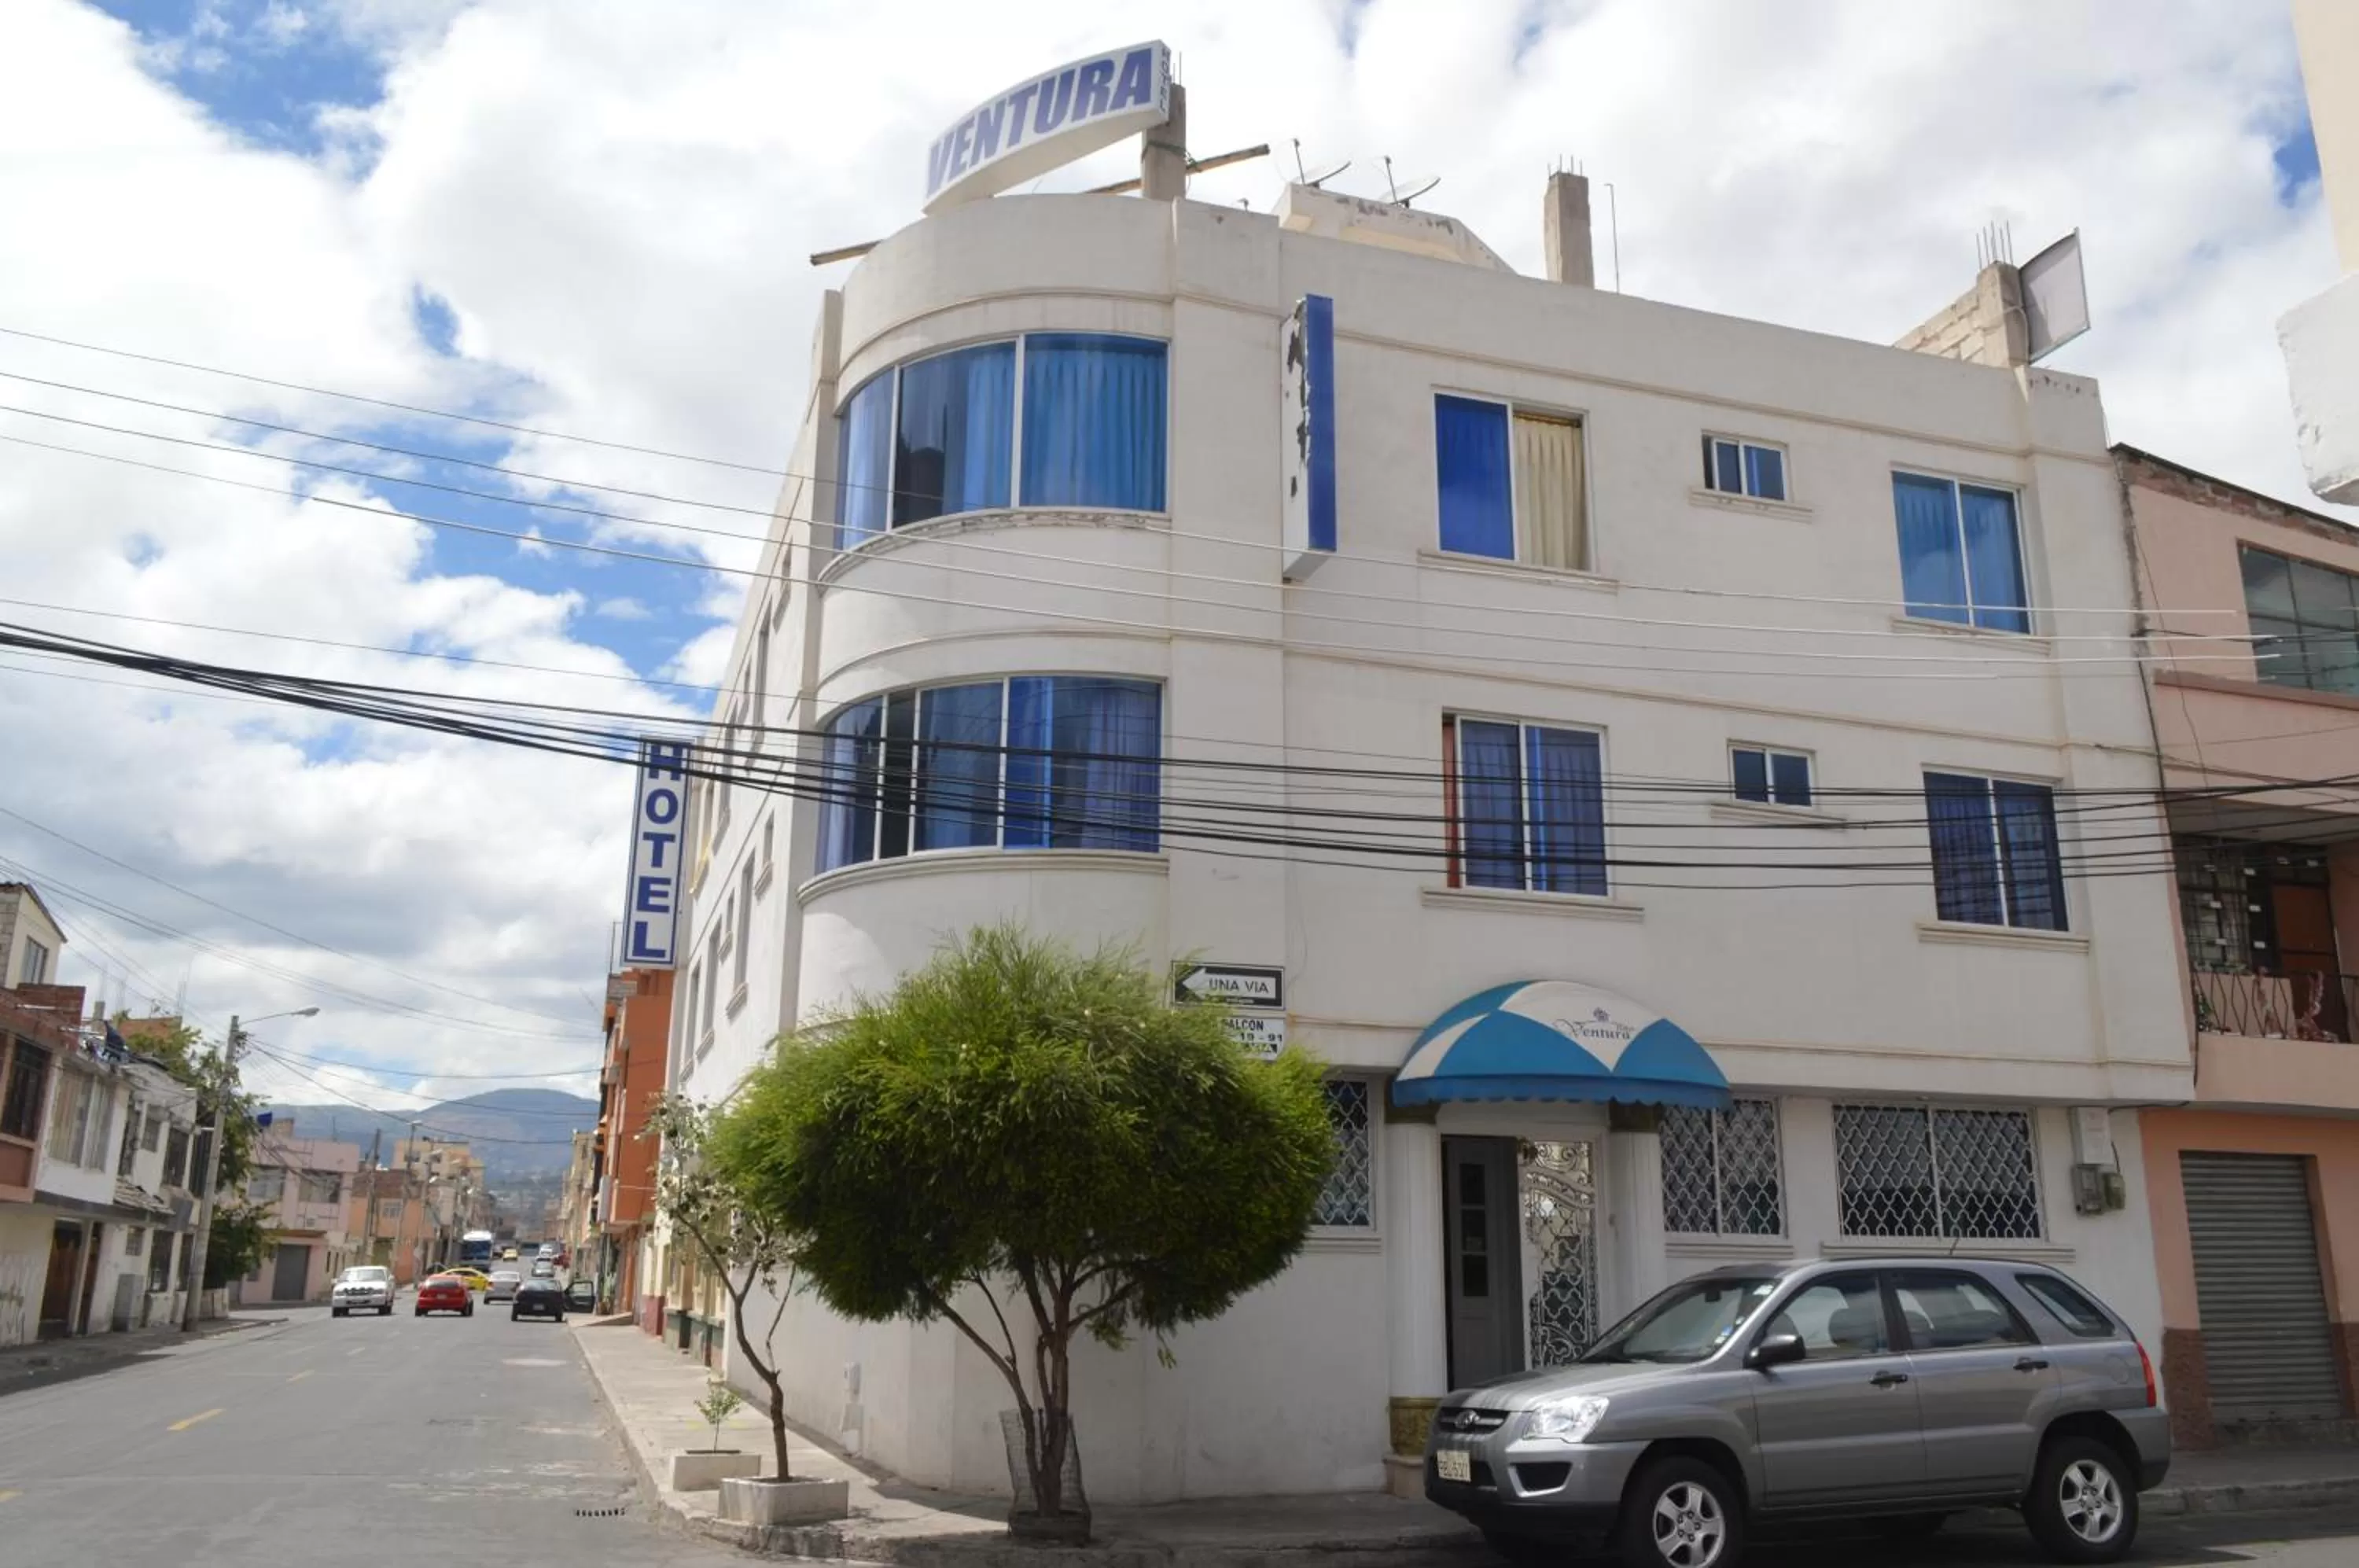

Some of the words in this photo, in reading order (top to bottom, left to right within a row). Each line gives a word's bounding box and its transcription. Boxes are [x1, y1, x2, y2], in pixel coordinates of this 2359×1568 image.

[926, 47, 1153, 200] VENTURA
[631, 743, 683, 959] HOTEL
[1209, 977, 1240, 992] UNA
[1244, 980, 1270, 994] VIA
[1555, 1018, 1631, 1040] Ventura
